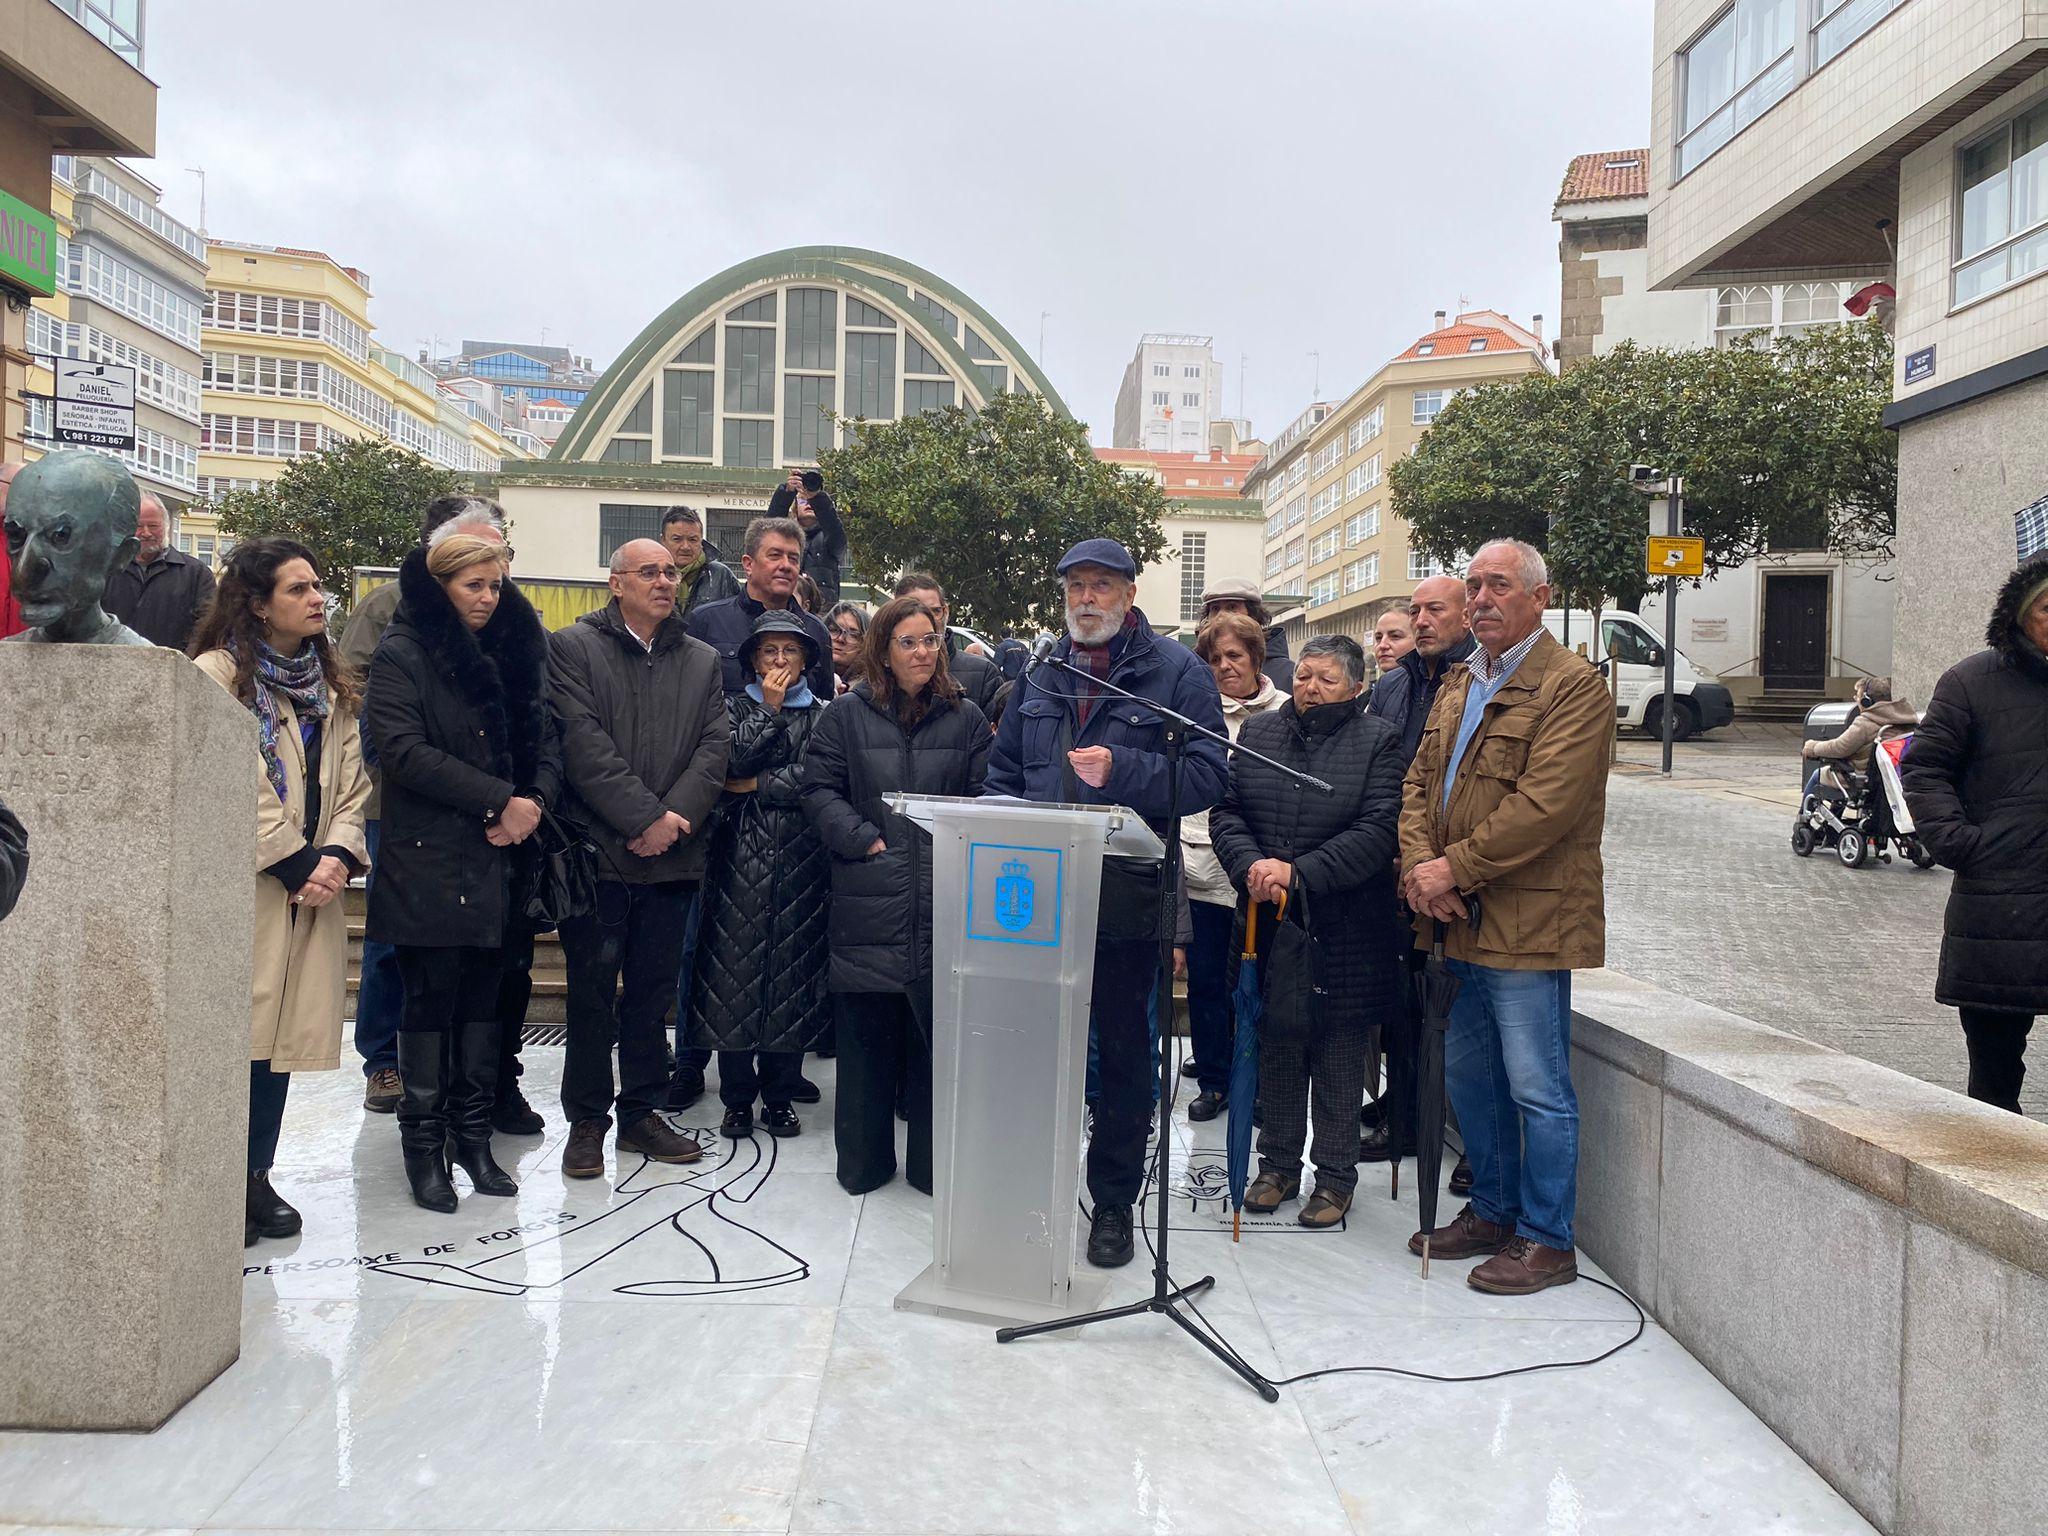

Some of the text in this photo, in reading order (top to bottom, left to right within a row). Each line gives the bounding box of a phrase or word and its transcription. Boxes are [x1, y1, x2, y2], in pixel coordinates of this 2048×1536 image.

[80, 383, 111, 396] DANIEL
[71, 404, 118, 416] BARBER SHOP
[62, 411, 94, 421] SEÑORAS
[98, 416, 127, 425] INFANTIL
[97, 424, 128, 433] PELUCAS
[72, 432, 124, 445] 981 223 867
[242, 1211, 577, 1277] PERSOAXE DE FORGES
